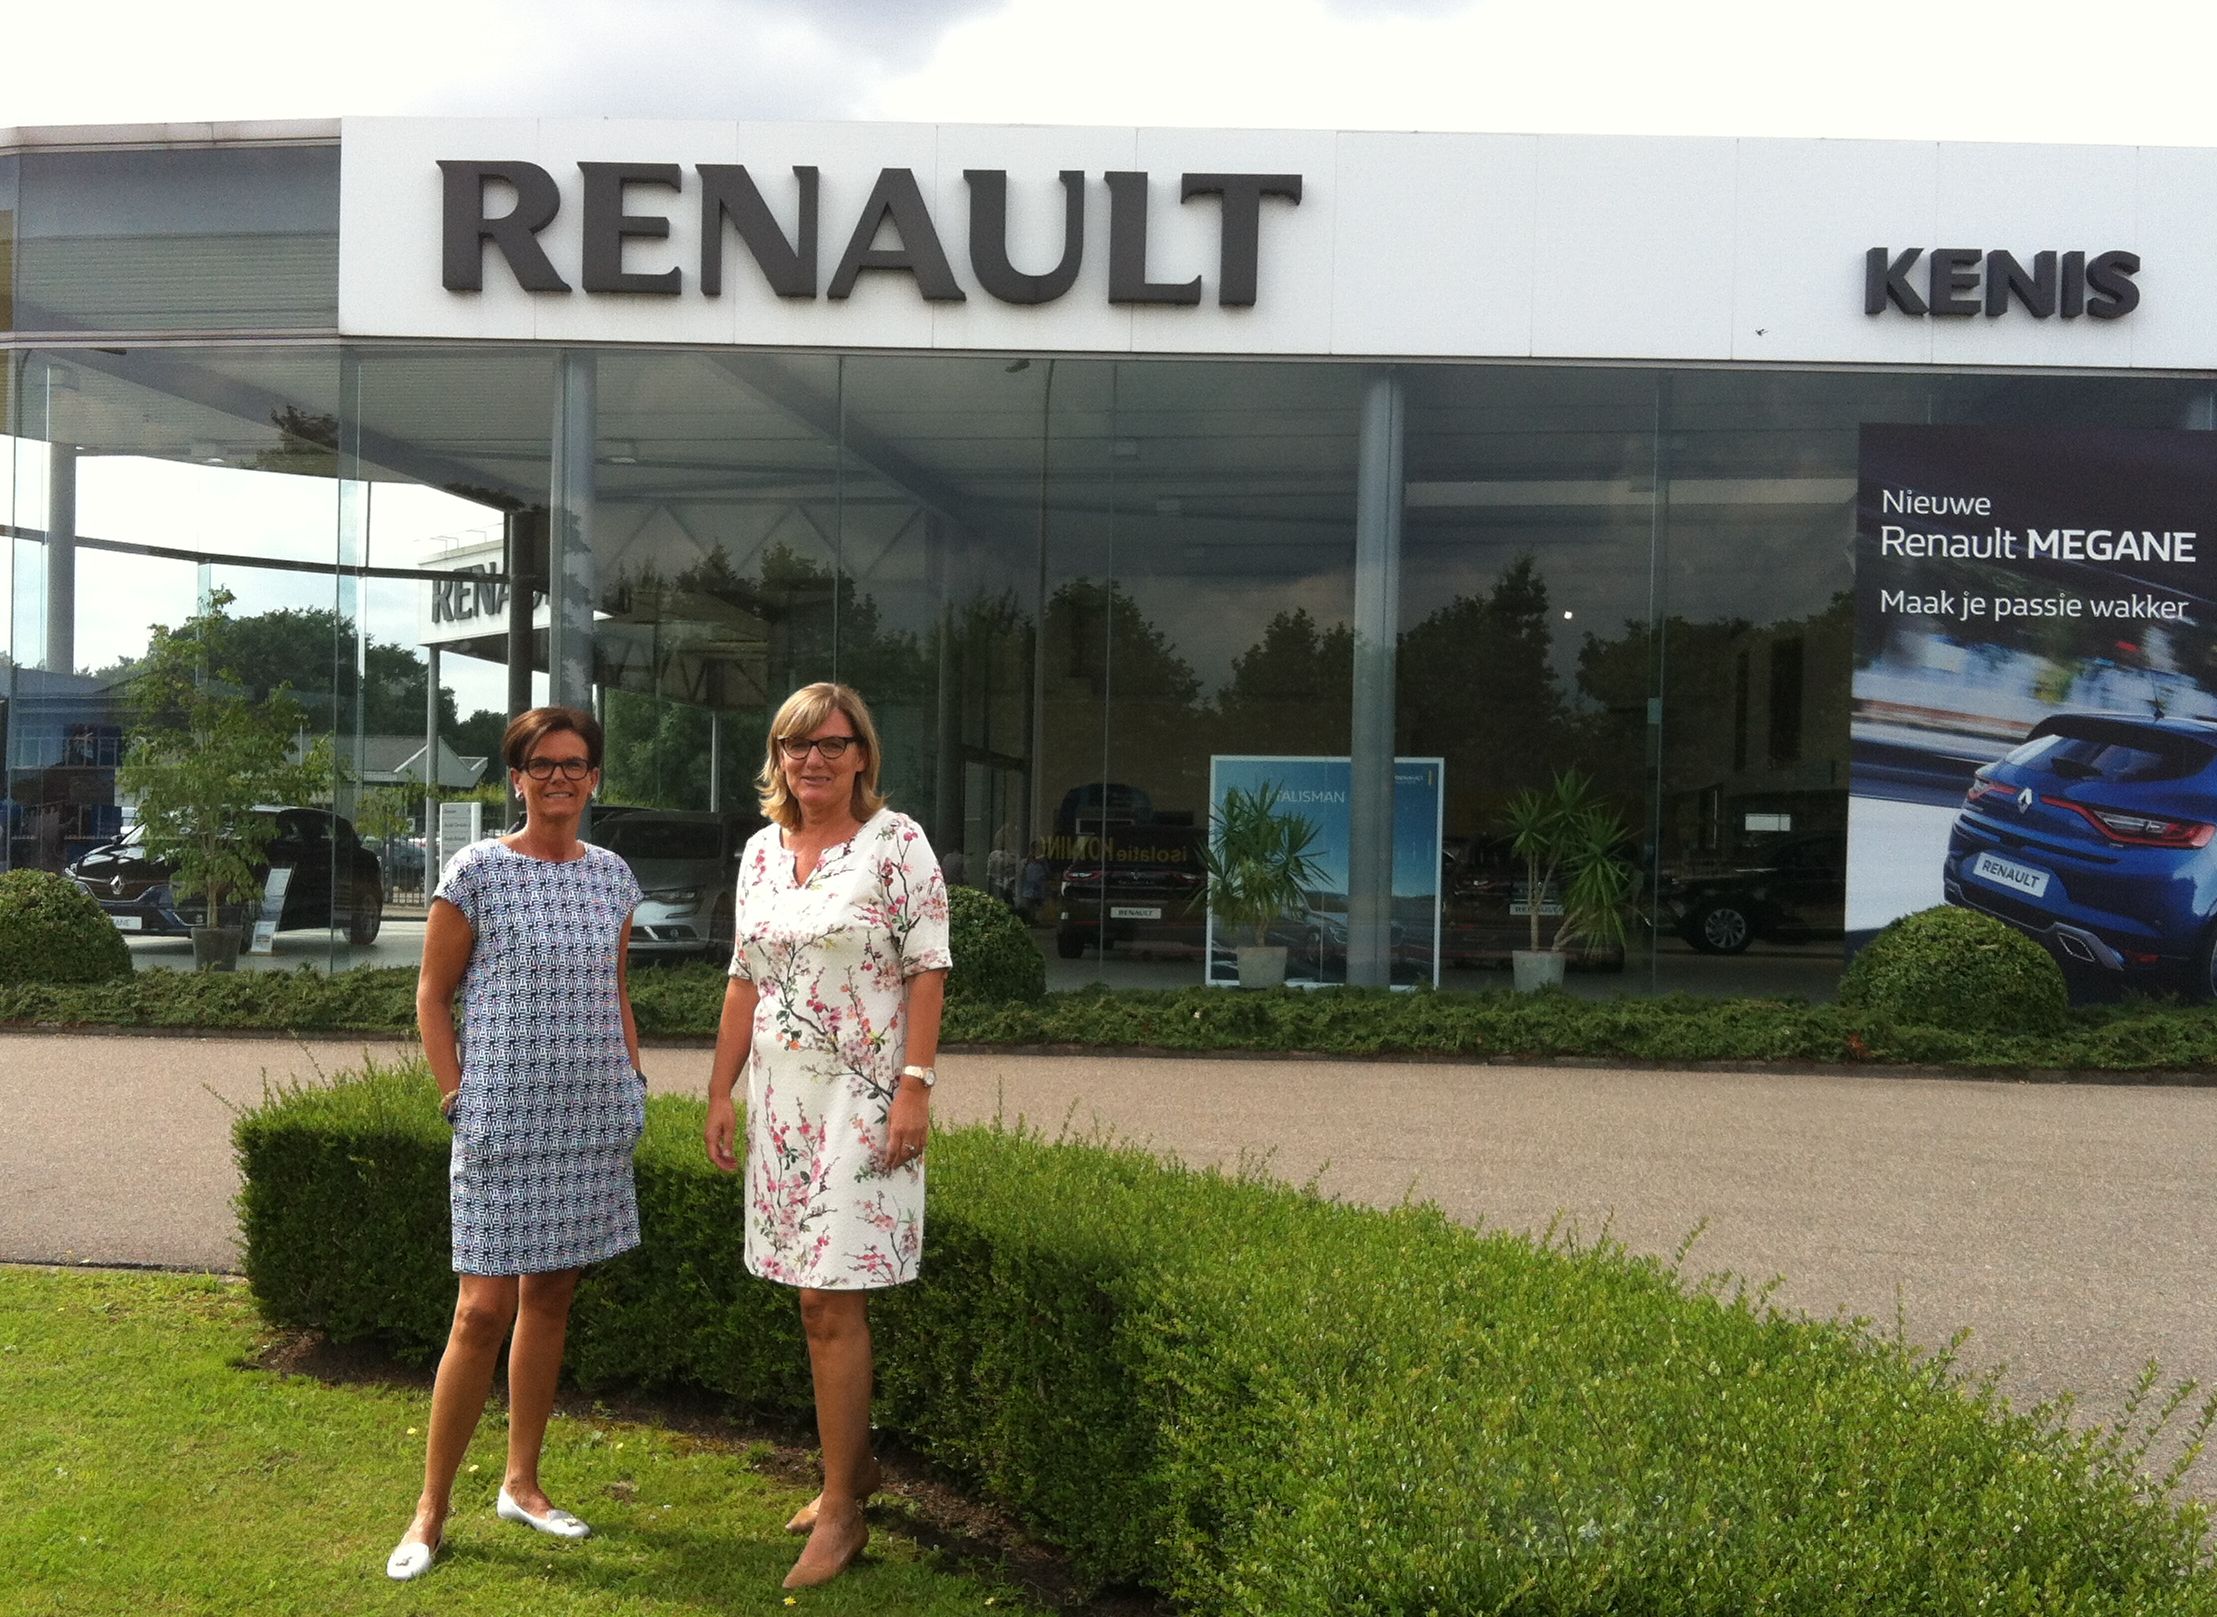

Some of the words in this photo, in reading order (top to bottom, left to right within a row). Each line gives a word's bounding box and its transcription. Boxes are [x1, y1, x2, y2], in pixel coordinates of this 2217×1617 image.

[435, 159, 1303, 307] RENAULT
[1864, 247, 2141, 319] KENIS
[1882, 489, 1992, 516] Nieuwe
[1881, 525, 2018, 560] Renault
[2026, 528, 2197, 563] MEGANE
[1880, 590, 1956, 614] Maak
[1960, 590, 1986, 622] je
[1994, 592, 2083, 621] passie
[2089, 594, 2190, 620] wakker
[1981, 859, 2041, 888] RENAULT
